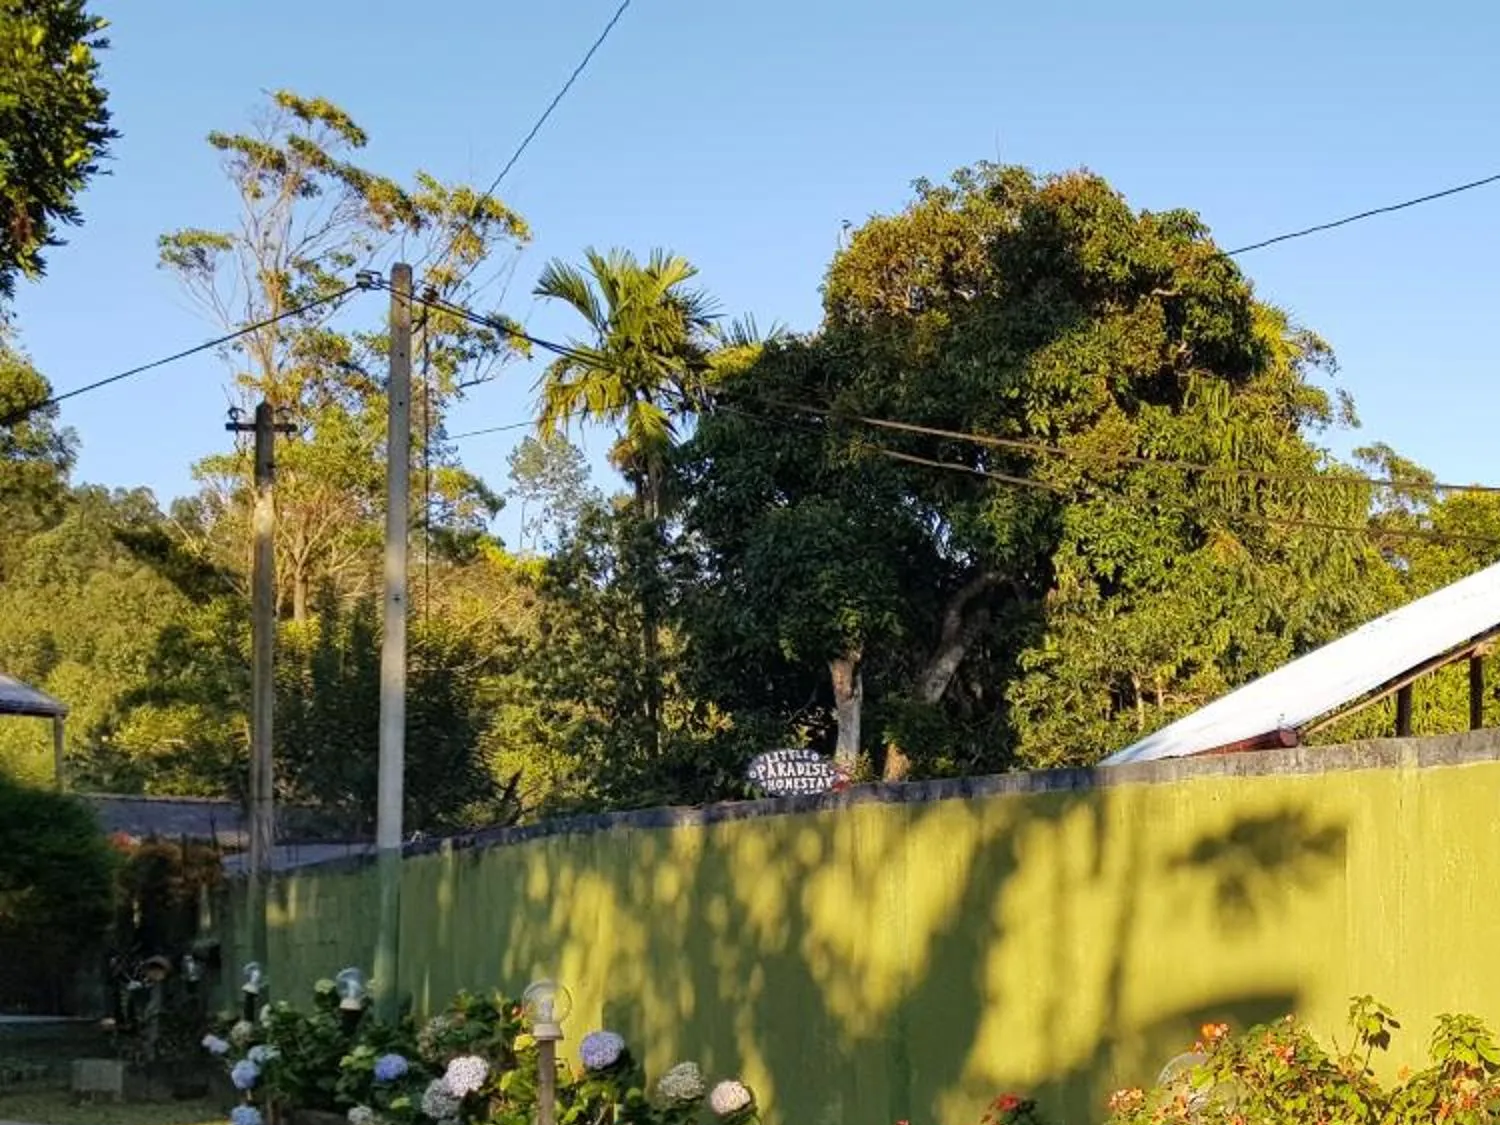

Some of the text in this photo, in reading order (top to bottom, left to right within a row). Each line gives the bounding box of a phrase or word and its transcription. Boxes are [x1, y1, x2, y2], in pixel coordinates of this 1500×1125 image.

[764, 748, 809, 763] LITTLE
[756, 761, 829, 780] PARADISE
[768, 776, 833, 791] HOMESTAY
